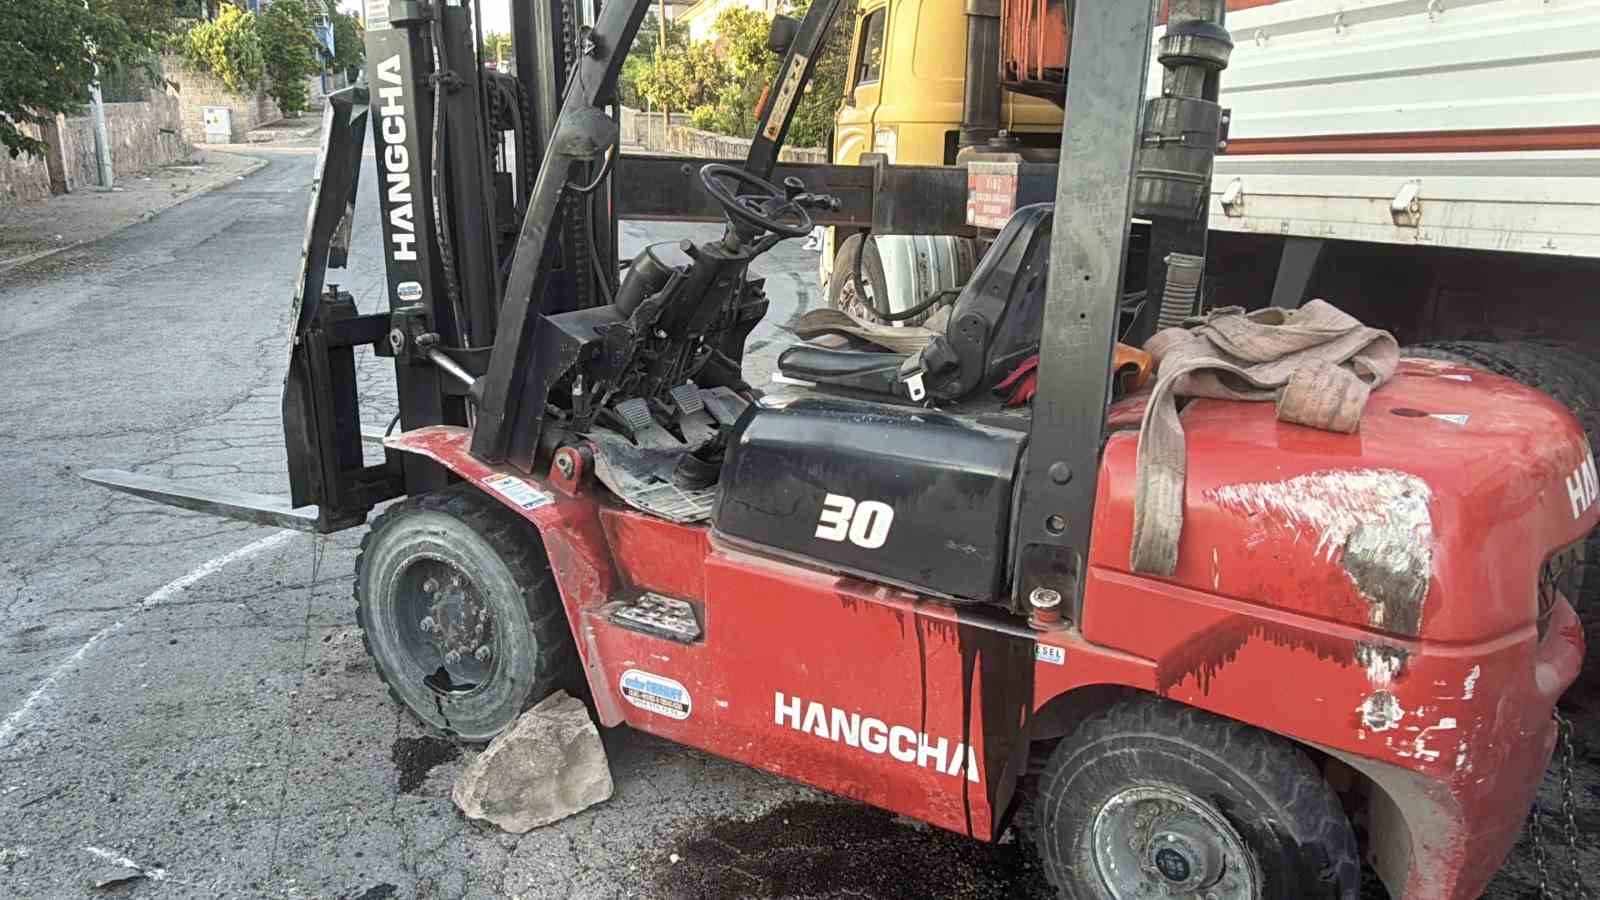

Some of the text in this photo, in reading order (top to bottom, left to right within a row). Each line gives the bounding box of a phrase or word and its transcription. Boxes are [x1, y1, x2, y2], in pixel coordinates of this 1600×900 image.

[377, 54, 417, 261] HANGCHA
[814, 493, 895, 549] 30
[774, 691, 981, 783] HANGCHA
